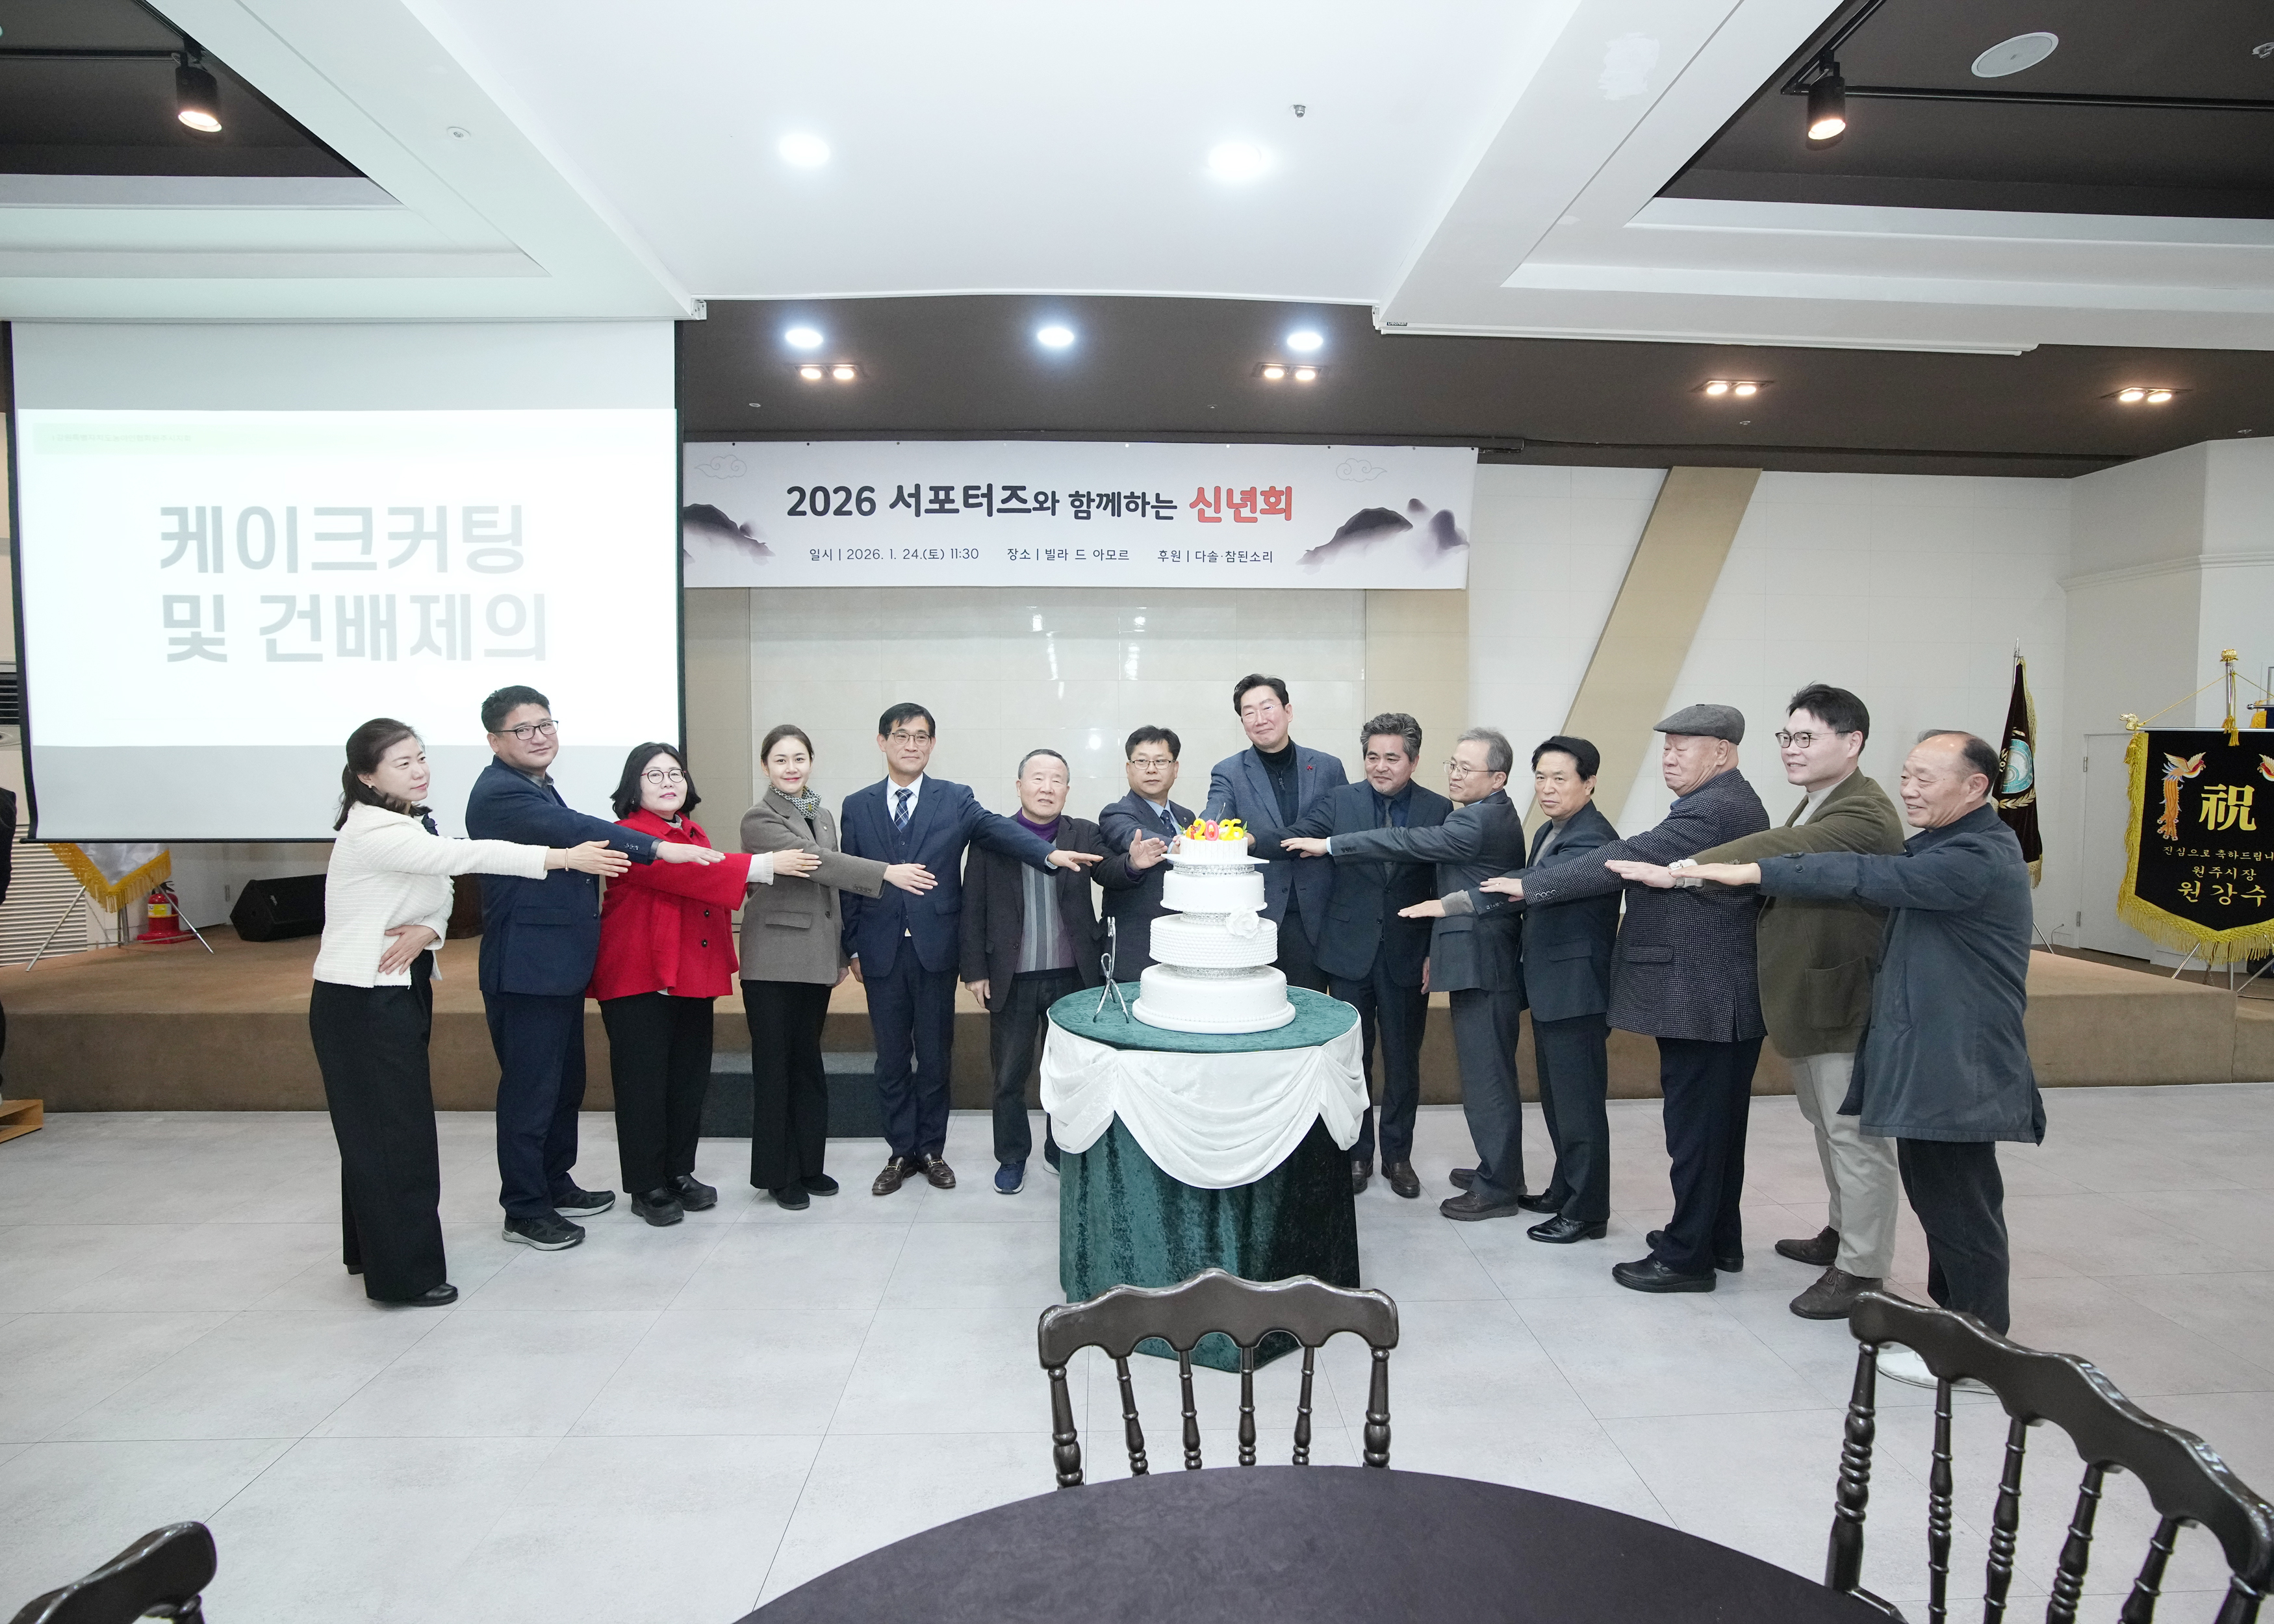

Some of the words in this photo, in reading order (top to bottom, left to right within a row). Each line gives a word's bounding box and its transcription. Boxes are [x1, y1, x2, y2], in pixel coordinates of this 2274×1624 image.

[787, 486, 876, 516] 2026
[889, 483, 1060, 517] 서포터즈와
[1068, 490, 1177, 520] 함께하는
[1190, 487, 1292, 522] 신년회
[160, 505, 524, 574] 케이크커팅
[810, 549, 832, 561] 일시
[847, 549, 883, 559] 2026.
[903, 549, 944, 560] 24.(토)
[951, 548, 978, 559] 11:30
[1008, 548, 1030, 561] 장소
[1045, 549, 1068, 561] 빌라
[1075, 550, 1086, 559] 드
[1093, 549, 1129, 561] 아모르
[1158, 550, 1180, 562] 후원
[162, 594, 227, 663] 및
[259, 594, 545, 662] 건배제의
[2199, 783, 2256, 830] 祝
[2164, 846, 2210, 857] 진심으로
[2192, 866, 2256, 882] 원주시장
